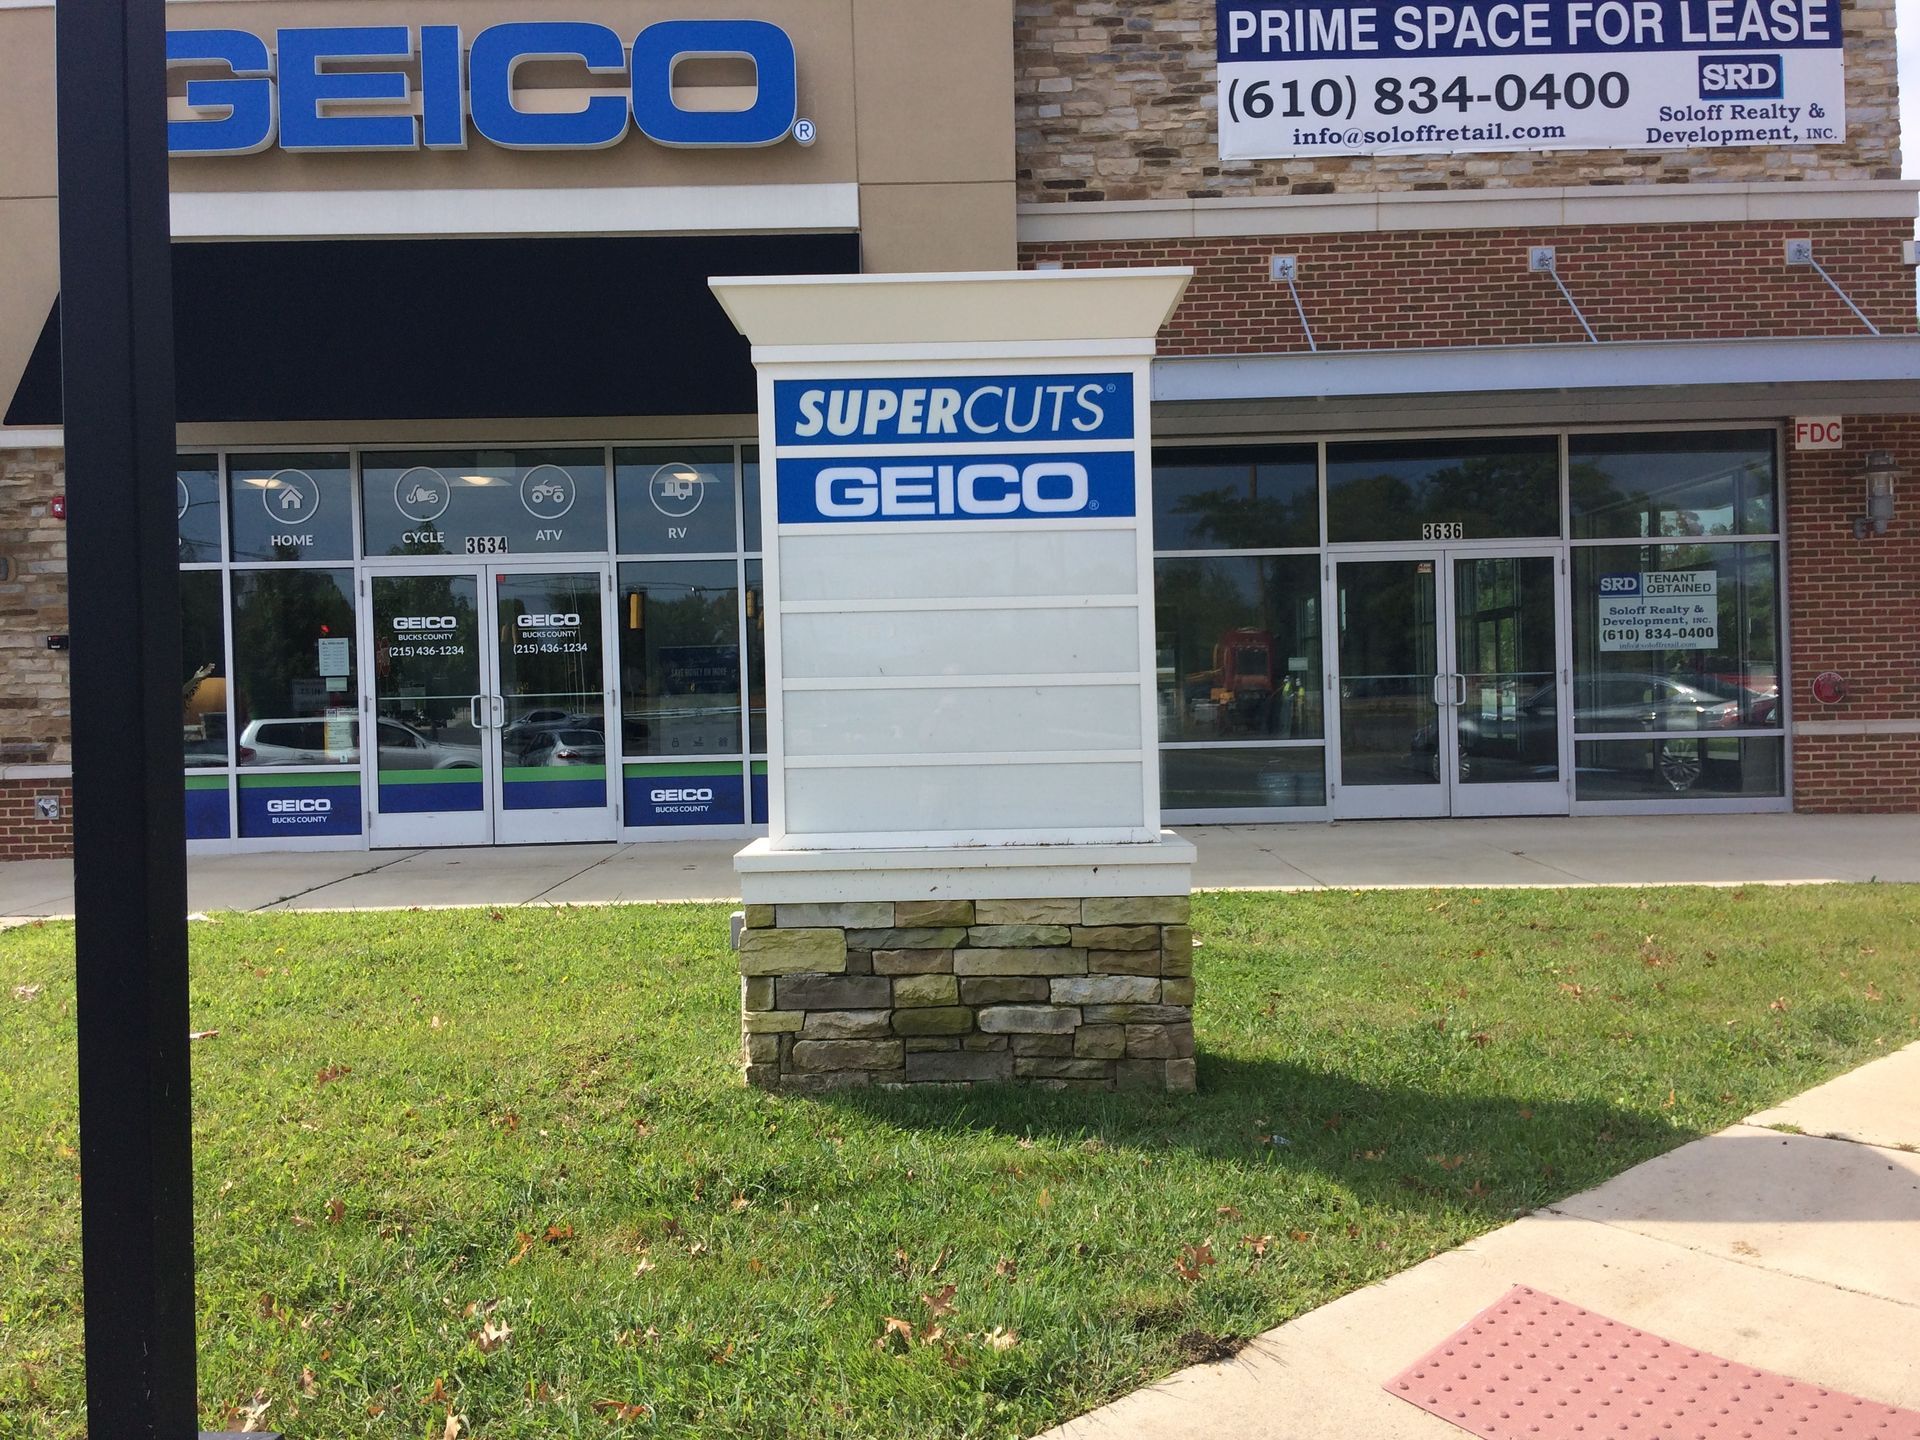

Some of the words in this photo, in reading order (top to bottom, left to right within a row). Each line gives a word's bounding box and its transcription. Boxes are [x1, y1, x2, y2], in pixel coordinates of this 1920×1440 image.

[1228, 8, 1379, 54] PRIME
[1393, 3, 1552, 51] SPACE
[1567, 1, 1664, 47] FOR
[1680, 0, 1831, 44] LEASE
[1702, 62, 1777, 91] SRD
[167, 19, 801, 155] GEICO
[1227, 74, 1358, 123] (610)
[1373, 71, 1630, 115] 834-0400
[1659, 104, 1725, 122] Soloff
[1730, 102, 1801, 123] Realty
[1808, 102, 1826, 119] &
[1292, 120, 1566, 148] info@soloffretail.com
[1646, 125, 1800, 146] Development,
[1806, 127, 1838, 140] INC.
[795, 383, 1105, 437] SUPERCUTS
[1796, 423, 1841, 443] FDC
[815, 462, 1089, 517] GEICO
[402, 532, 445, 544] CYCLE
[535, 529, 563, 541] ATV
[668, 526, 687, 538] RV
[1423, 523, 1462, 540] 3636
[271, 534, 314, 547] HOME
[466, 538, 506, 553] 3634
[1600, 577, 1637, 592] SRD
[1647, 574, 1696, 583] TENANT
[1647, 583, 1711, 593] OBTAINED
[1609, 606, 1646, 615] Soloff
[1650, 605, 1690, 616] Realty
[1694, 605, 1704, 614] &
[393, 616, 457, 630] GEICO
[517, 613, 581, 627] GEICO
[1603, 617, 1688, 628] Development,
[422, 633, 453, 641] COUNTY
[522, 631, 546, 639] BUCKS
[547, 630, 577, 638] COUNTY
[1603, 629, 1640, 643] (610)
[1645, 627, 1714, 639] 834-0400
[389, 646, 415, 658] (215)
[416, 646, 465, 656] 436-1234
[513, 644, 539, 655] (215)
[540, 643, 588, 653] 436-1234
[651, 788, 712, 801] GEICO
[267, 799, 331, 812] GEICO
[296, 816, 327, 824] COUNTY
